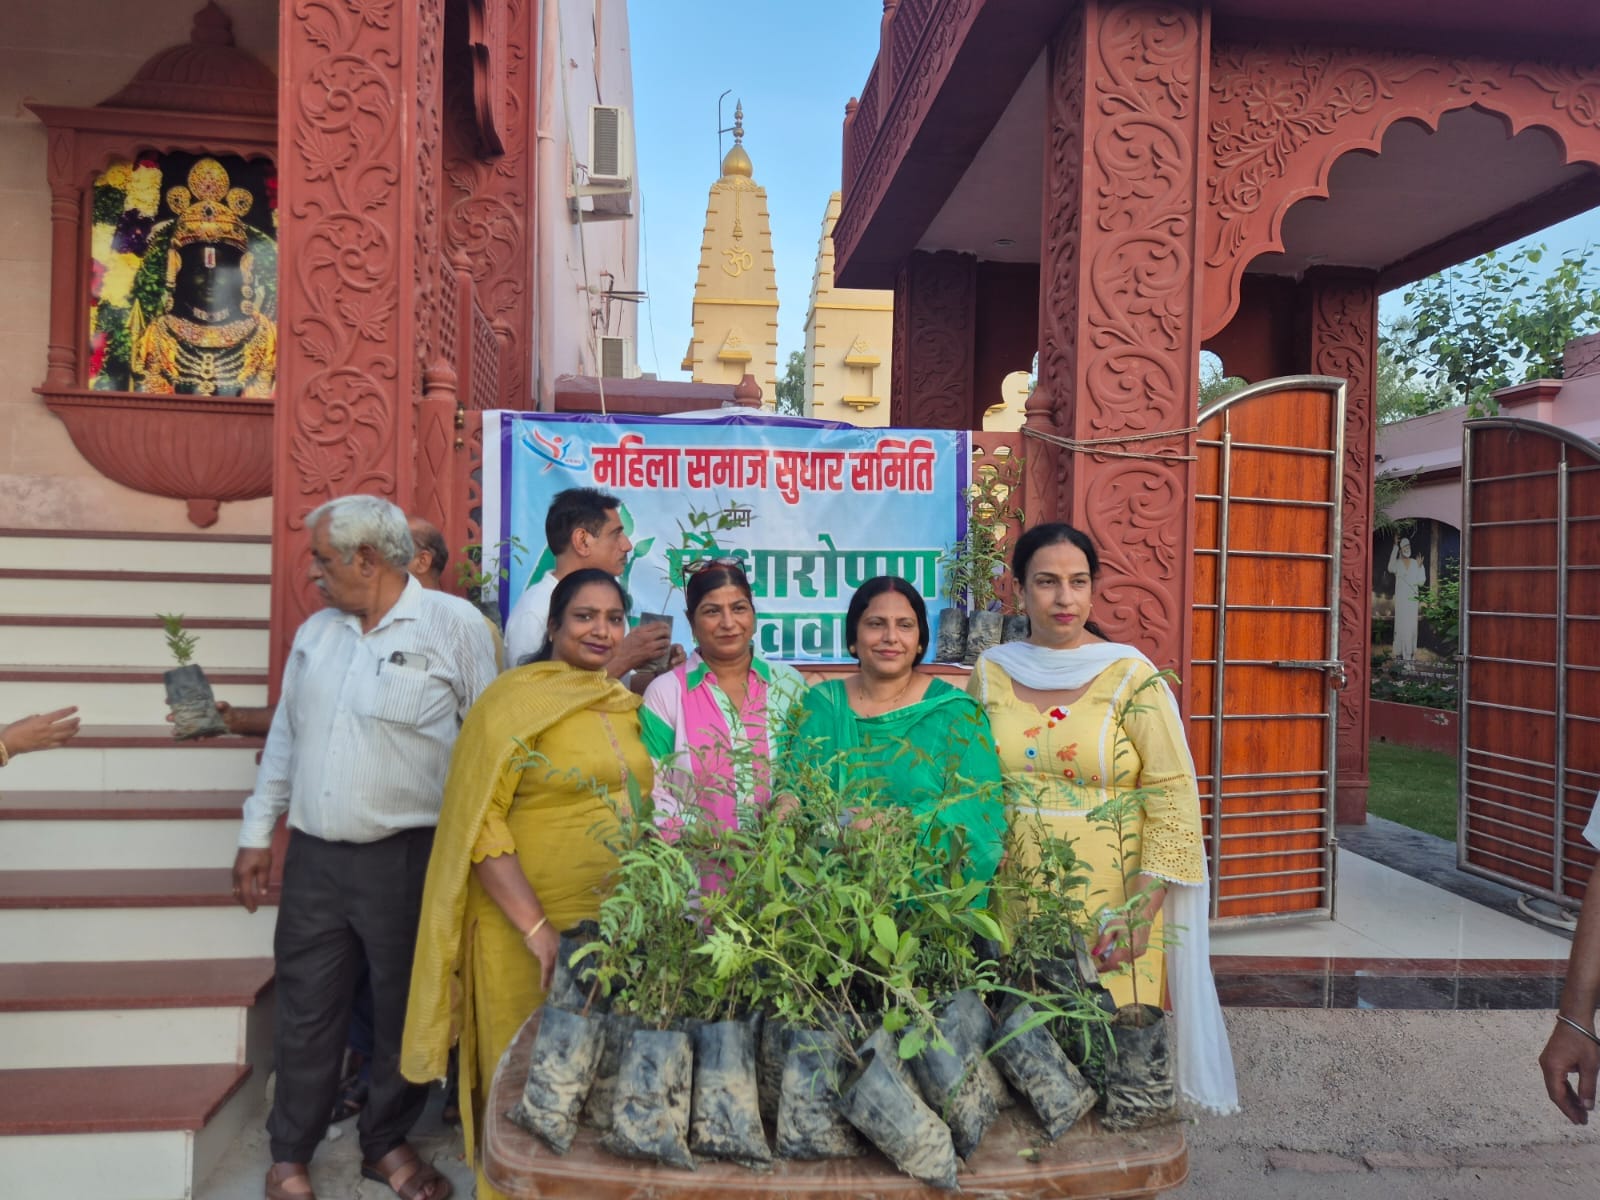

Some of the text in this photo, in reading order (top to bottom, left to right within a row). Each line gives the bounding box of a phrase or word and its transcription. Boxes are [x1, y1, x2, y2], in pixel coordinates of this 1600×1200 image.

[591, 434, 935, 505] महिला समाज सुधार समिति
